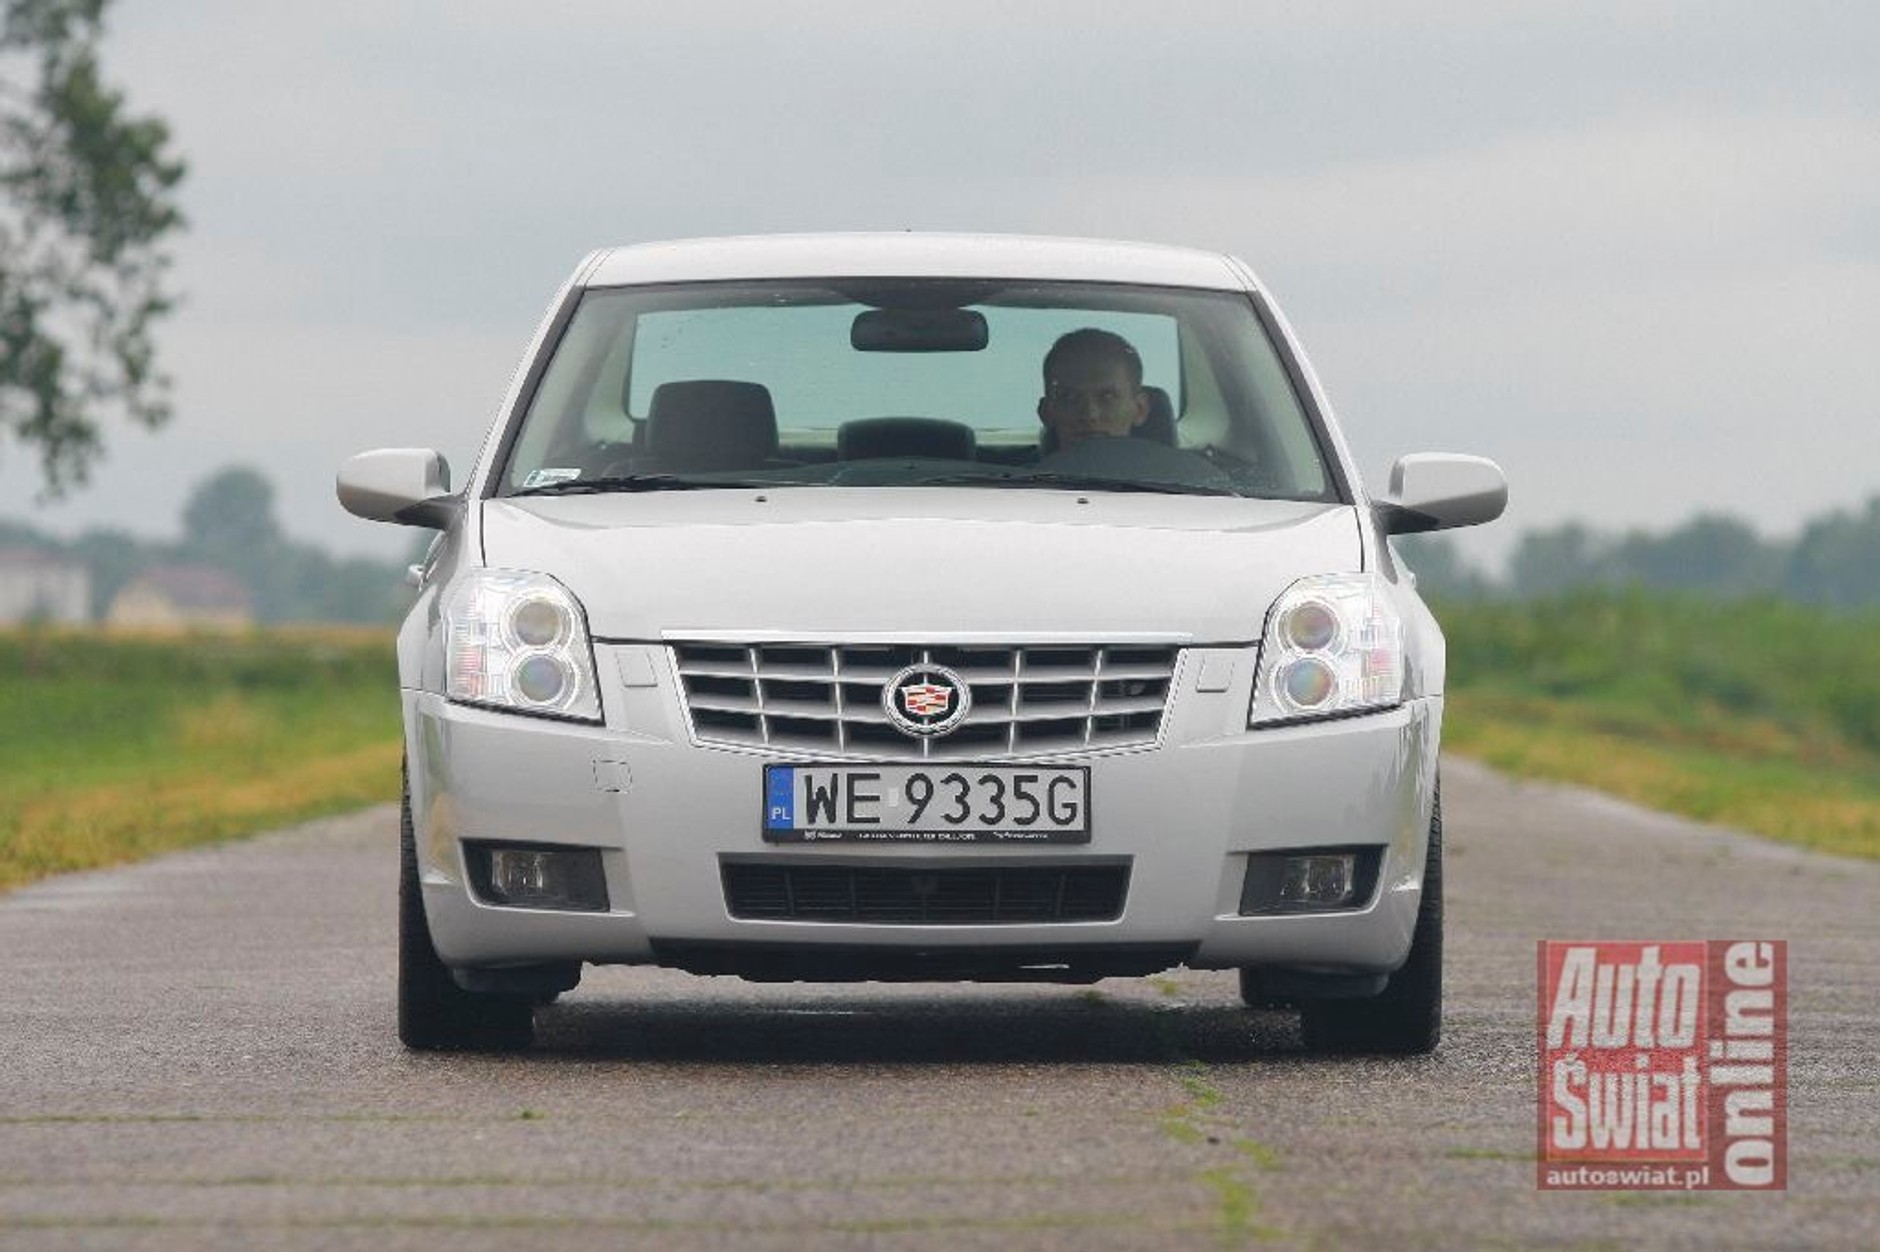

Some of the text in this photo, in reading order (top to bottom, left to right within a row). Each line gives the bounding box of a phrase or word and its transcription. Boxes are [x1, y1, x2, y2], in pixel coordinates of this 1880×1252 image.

[771, 807, 791, 820] PL
[804, 772, 1077, 825] WE 9335G
